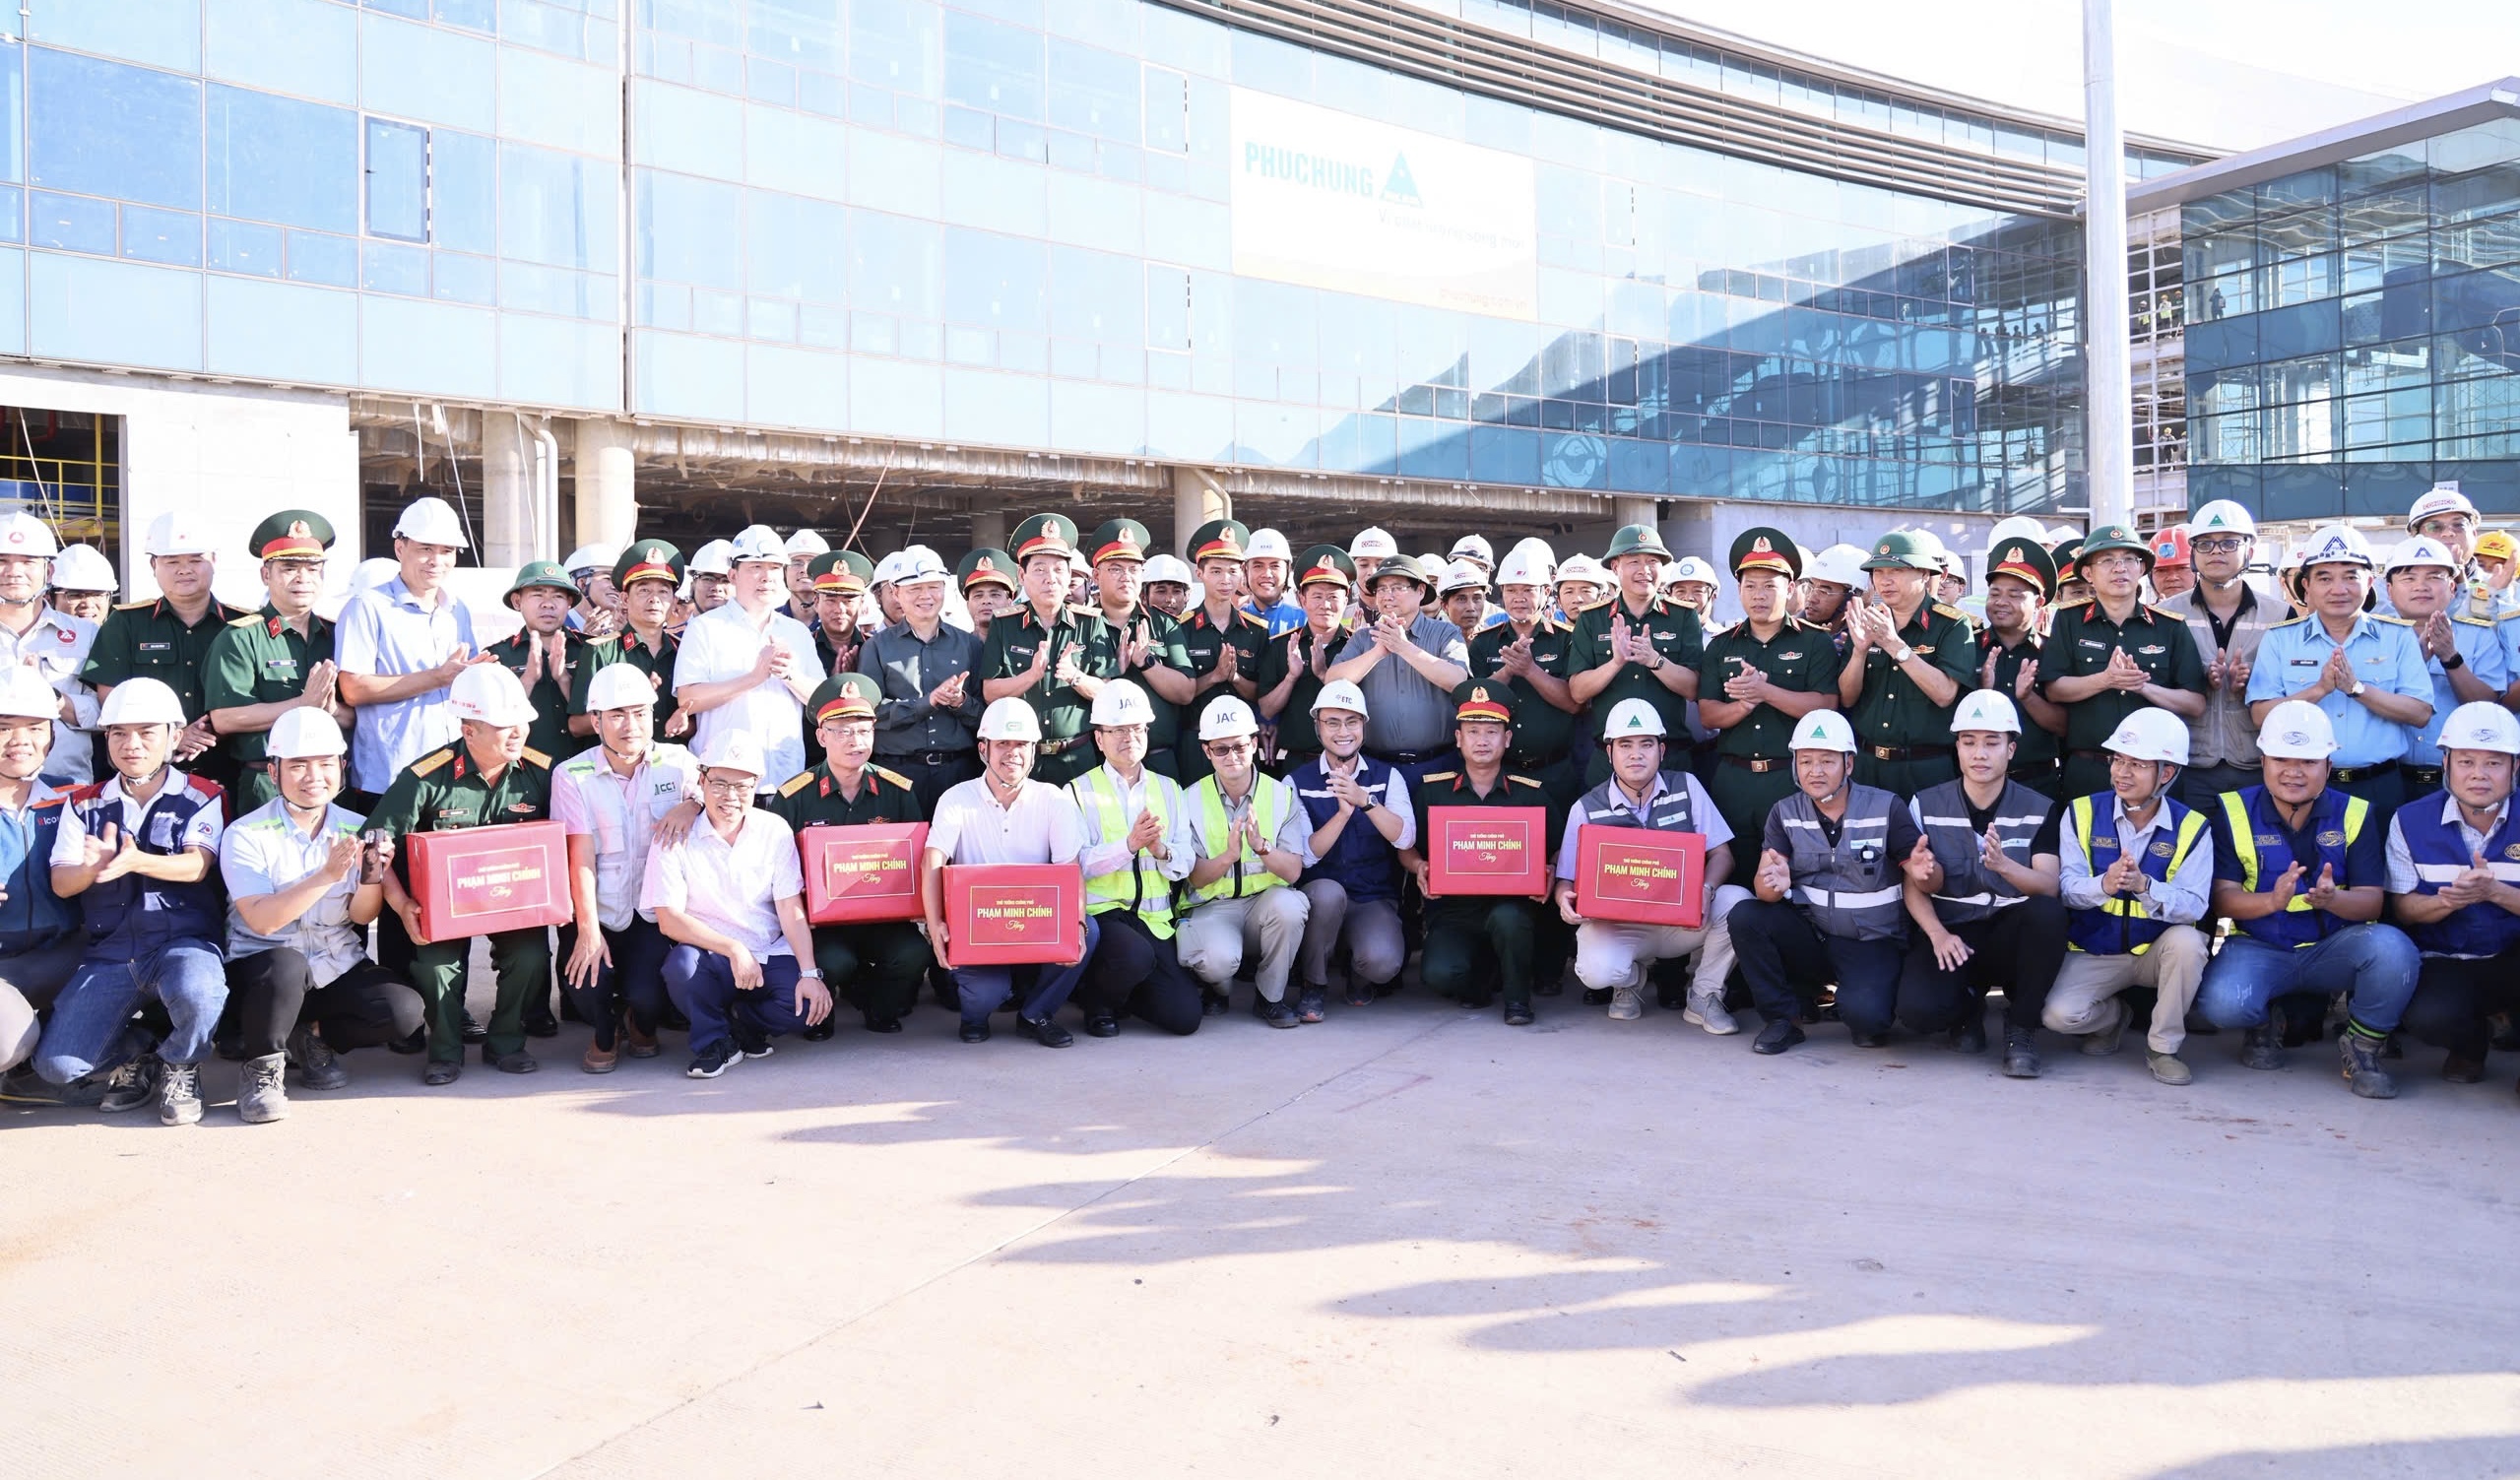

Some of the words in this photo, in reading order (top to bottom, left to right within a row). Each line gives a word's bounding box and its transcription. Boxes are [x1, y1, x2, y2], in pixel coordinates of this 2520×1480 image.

[1244, 141, 1374, 199] PHUCHUNG
[1119, 697, 1140, 710] JAC
[1341, 695, 1353, 705] ETC
[1216, 711, 1238, 725] JAC
[1453, 840, 1475, 852] PHẠM
[1476, 841, 1496, 851] MINH
[1498, 838, 1521, 851] CHÍNH
[833, 862, 858, 874] PHẠM
[859, 861, 880, 871] MINH
[881, 858, 907, 870] CHÍNH
[1604, 864, 1628, 876] PHẠM
[1629, 866, 1650, 877] MINH
[1651, 866, 1677, 879] CHÍNH
[977, 907, 1002, 920] PHẠM
[1002, 907, 1025, 918] MINH
[1026, 904, 1053, 918] CHÍNH
